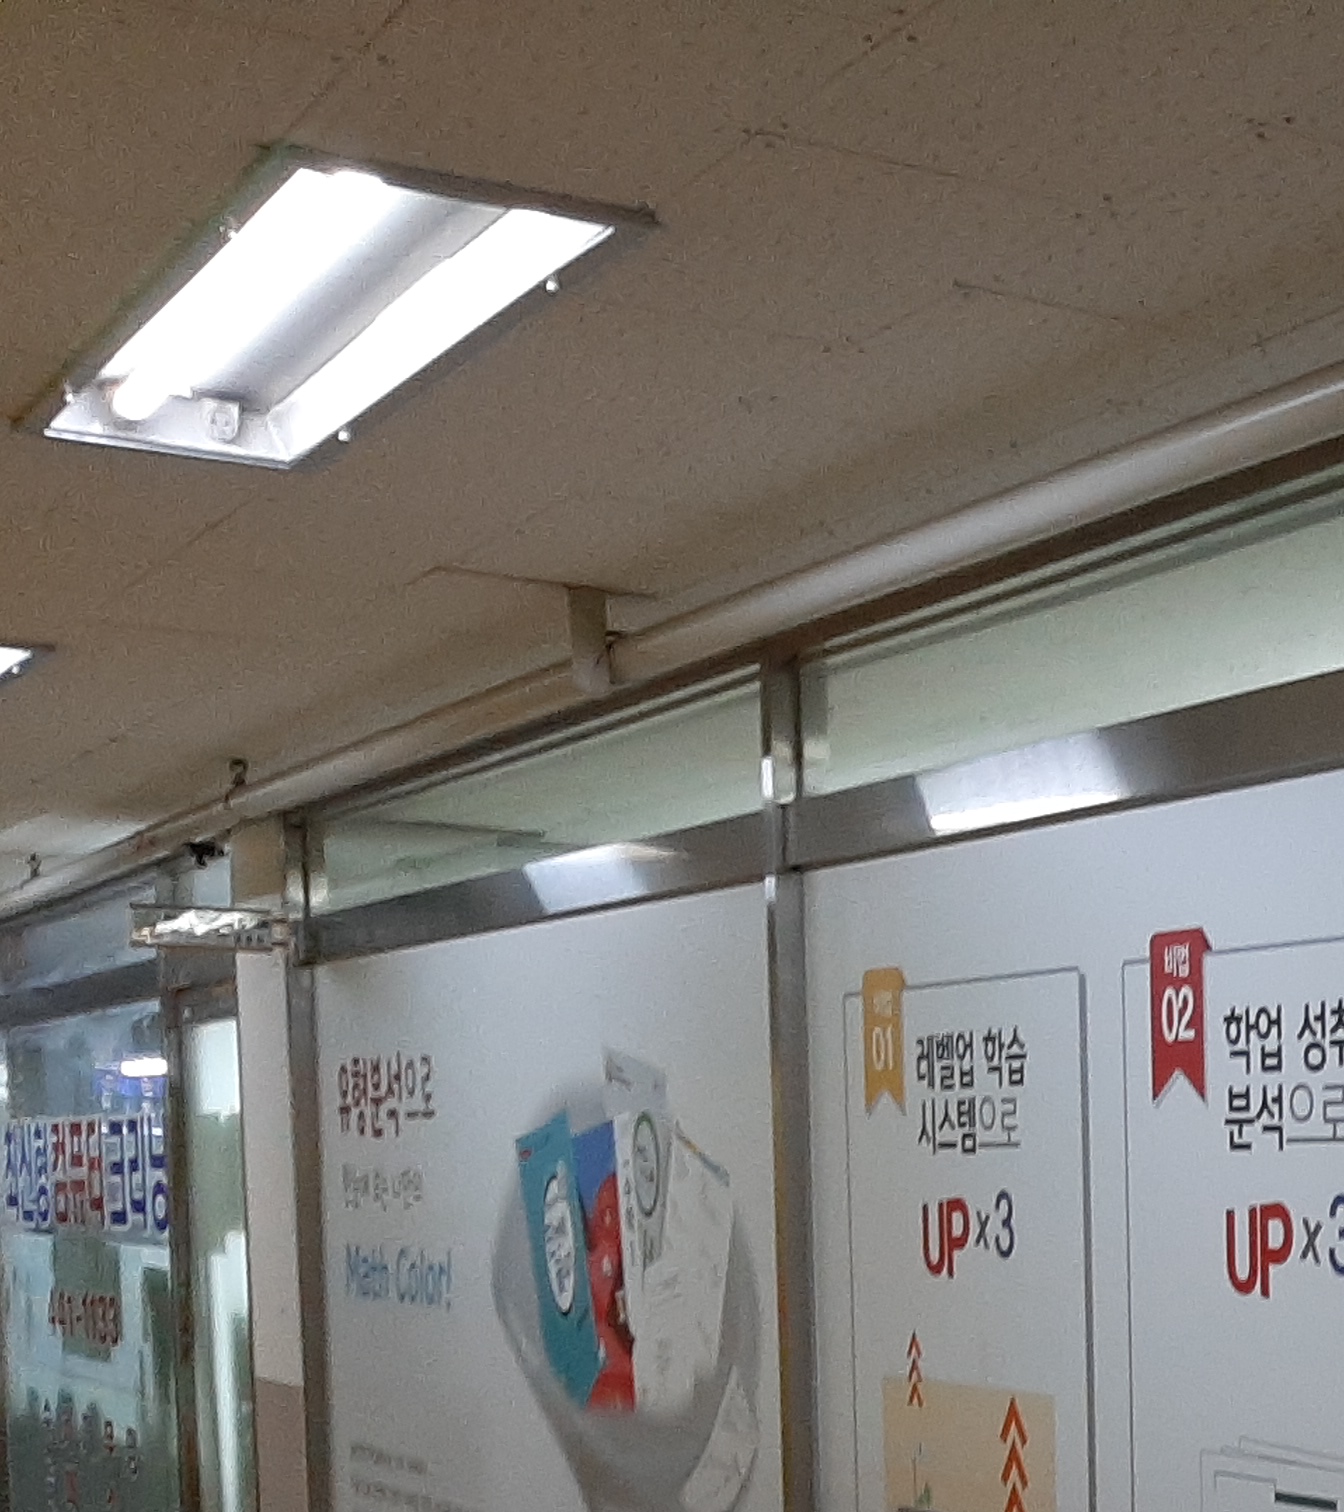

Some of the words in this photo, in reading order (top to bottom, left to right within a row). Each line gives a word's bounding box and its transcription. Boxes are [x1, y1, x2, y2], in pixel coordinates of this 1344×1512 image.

[1161, 984, 1196, 1044] 02
[1223, 1003, 1283, 1074] 학업
[873, 1026, 893, 1072] 01
[916, 1030, 974, 1090] 레벨업
[983, 1025, 1027, 1089] 학습
[918, 1094, 1021, 1155] 시스템으로
